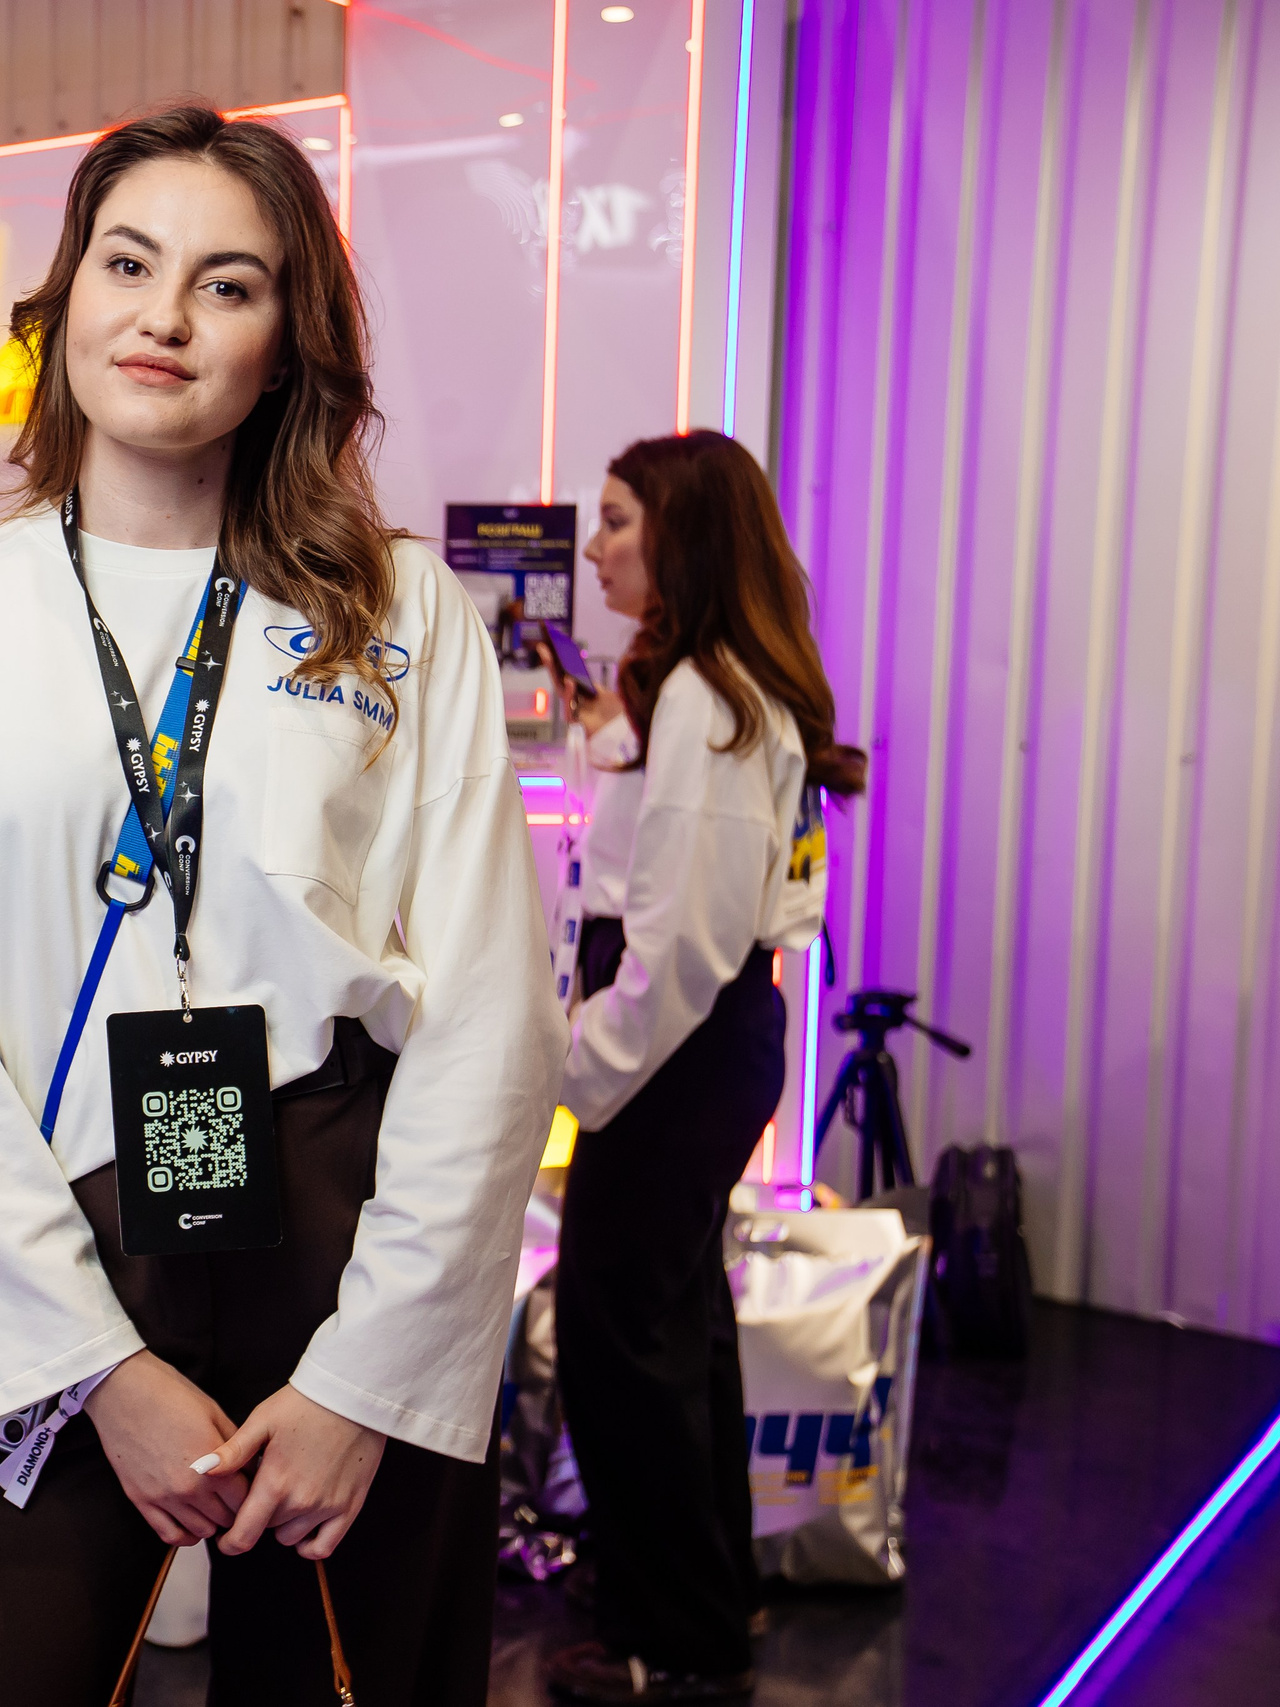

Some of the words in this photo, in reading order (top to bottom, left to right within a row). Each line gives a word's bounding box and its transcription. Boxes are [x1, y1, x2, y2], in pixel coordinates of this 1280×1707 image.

[215, 592, 223, 608] CONF
[218, 593, 230, 628] CONVERSION
[266, 675, 345, 705] JULIA
[353, 690, 395, 731] SMM
[189, 713, 206, 753] GYPSY
[130, 753, 151, 793] GYPSY
[184, 854, 192, 896] CONVERSION
[175, 1049, 219, 1065] GYPSY
[191, 1213, 224, 1221] CONVERSION
[17, 1426, 53, 1487] DIAMOND+
